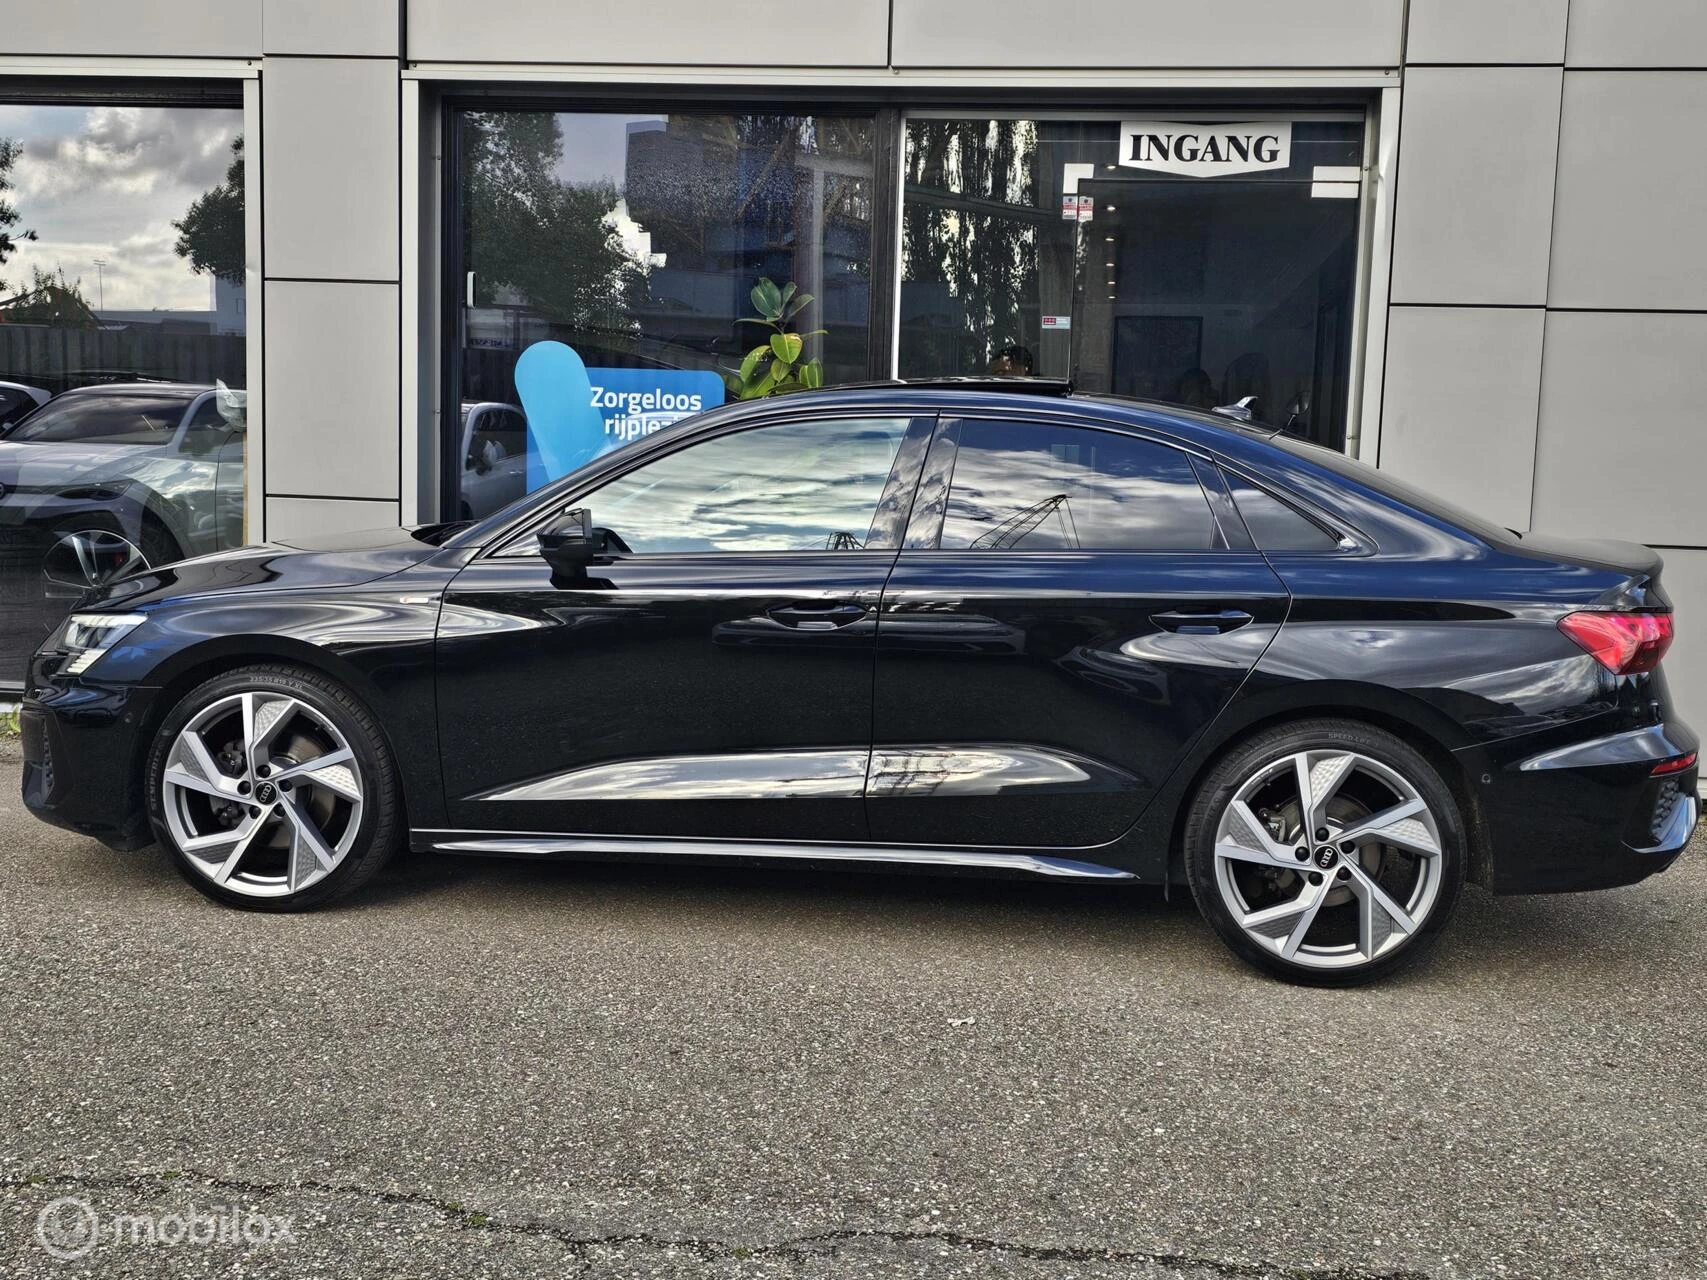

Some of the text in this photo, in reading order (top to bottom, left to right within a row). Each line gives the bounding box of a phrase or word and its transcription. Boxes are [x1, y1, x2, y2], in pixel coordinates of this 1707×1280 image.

[1129, 134, 1280, 163] INGANG
[590, 386, 702, 413] Zorgeloos
[605, 414, 679, 441] rijple
